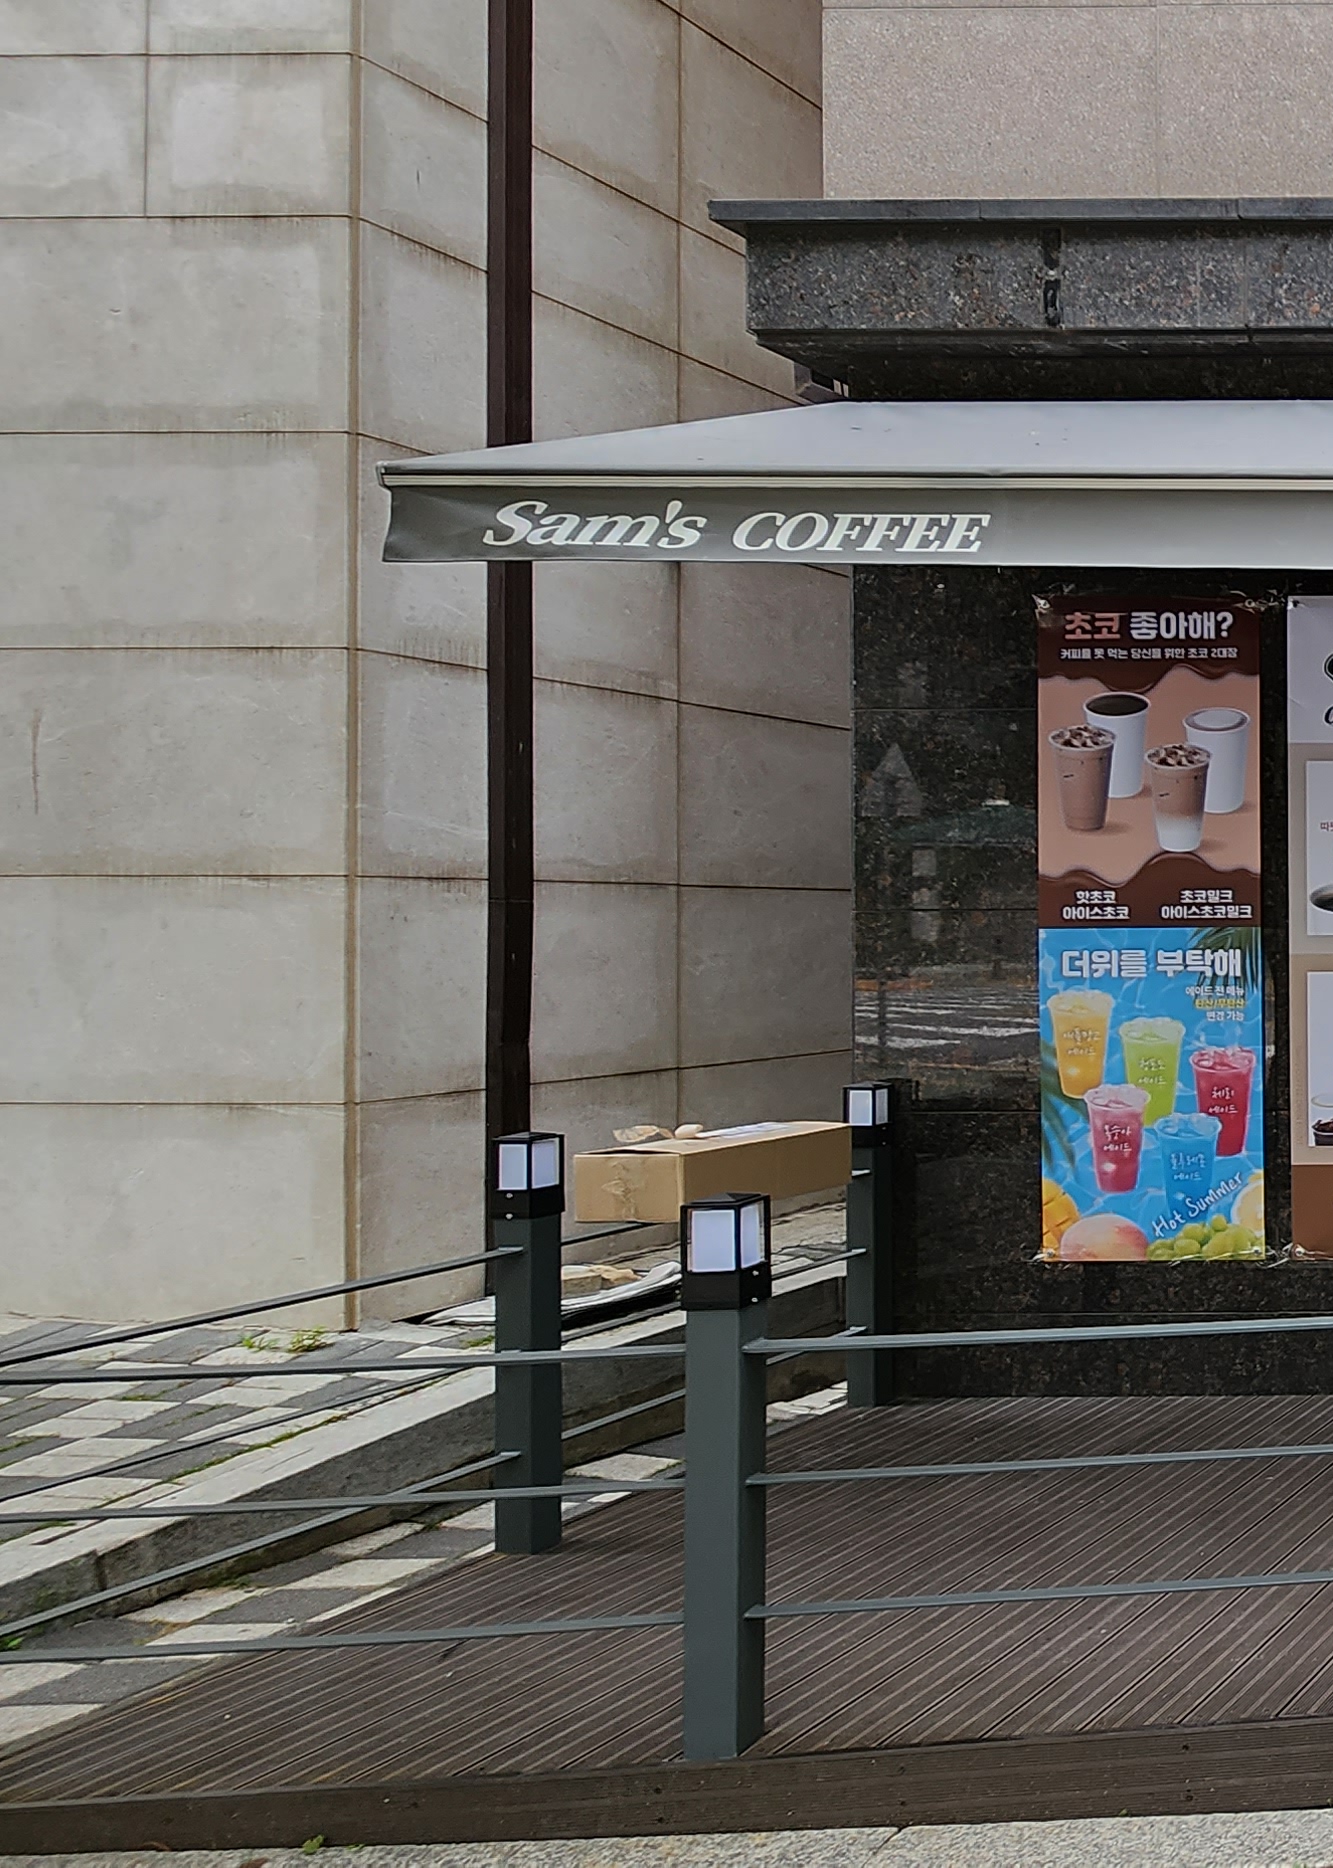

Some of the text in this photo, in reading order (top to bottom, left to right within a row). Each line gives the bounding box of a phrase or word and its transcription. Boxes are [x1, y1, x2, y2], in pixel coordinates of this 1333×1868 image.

[483, 499, 991, 553] Sam's COFFEE
[1064, 611, 1234, 640] 초코 좋아해?
[1075, 890, 1117, 905] 핫초코
[1180, 889, 1233, 903] 초코밀크
[1062, 905, 1130, 919] 아이스초코
[1161, 904, 1252, 919] 아이스초코밀크
[1061, 948, 1242, 978] 더위를 부탁해
[1151, 1210, 1186, 1238] Hot
